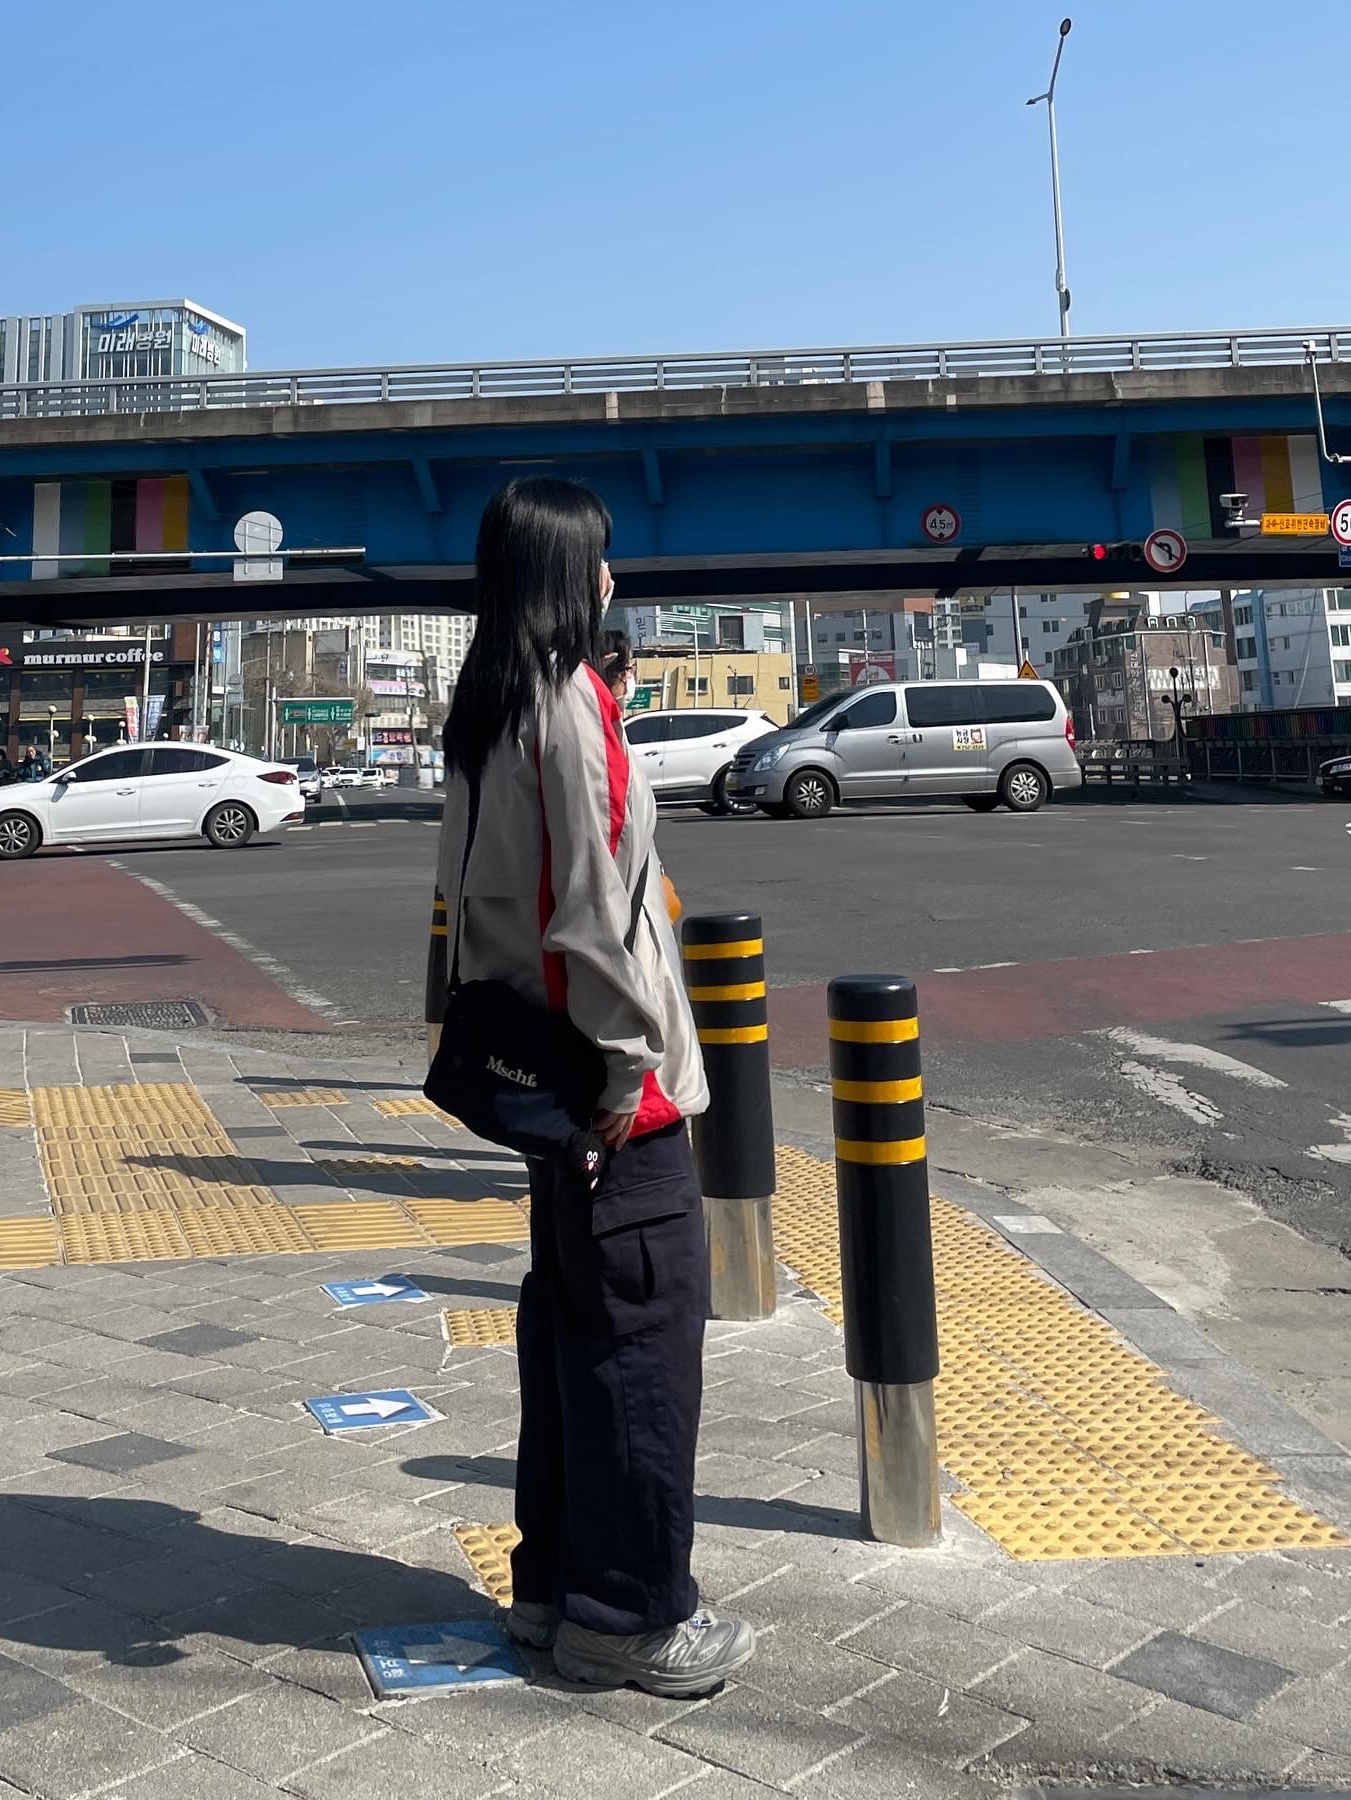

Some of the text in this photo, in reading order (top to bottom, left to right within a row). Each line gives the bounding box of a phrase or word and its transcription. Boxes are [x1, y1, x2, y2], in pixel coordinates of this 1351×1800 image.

[97, 330, 172, 353] 미래병원
[1340, 513, 1351, 533] 5
[23, 653, 104, 665] murmur
